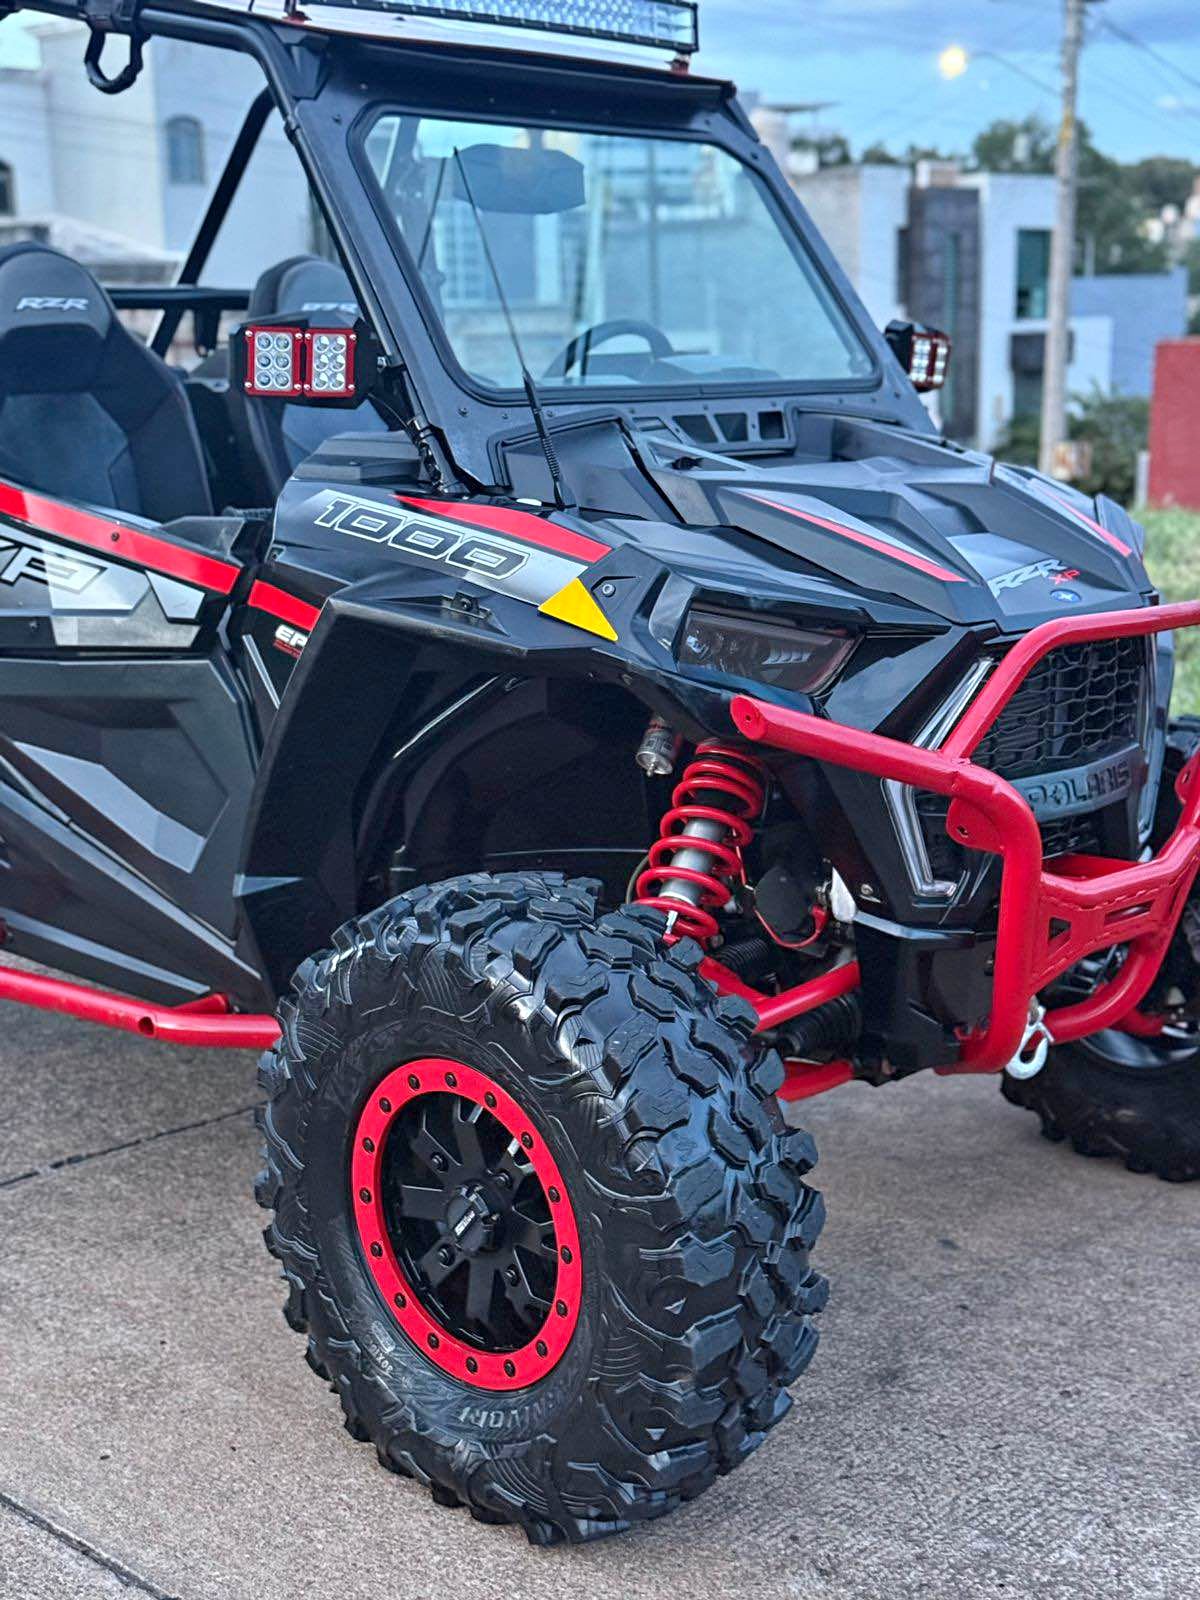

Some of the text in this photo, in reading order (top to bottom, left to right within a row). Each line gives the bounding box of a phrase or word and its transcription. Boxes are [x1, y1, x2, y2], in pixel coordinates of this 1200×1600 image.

[16, 297, 88, 311] RZR
[313, 497, 531, 580] 1000
[987, 559, 1081, 598] RZR XP
[275, 624, 309, 648] EP
[1023, 759, 1130, 812] POLARIS
